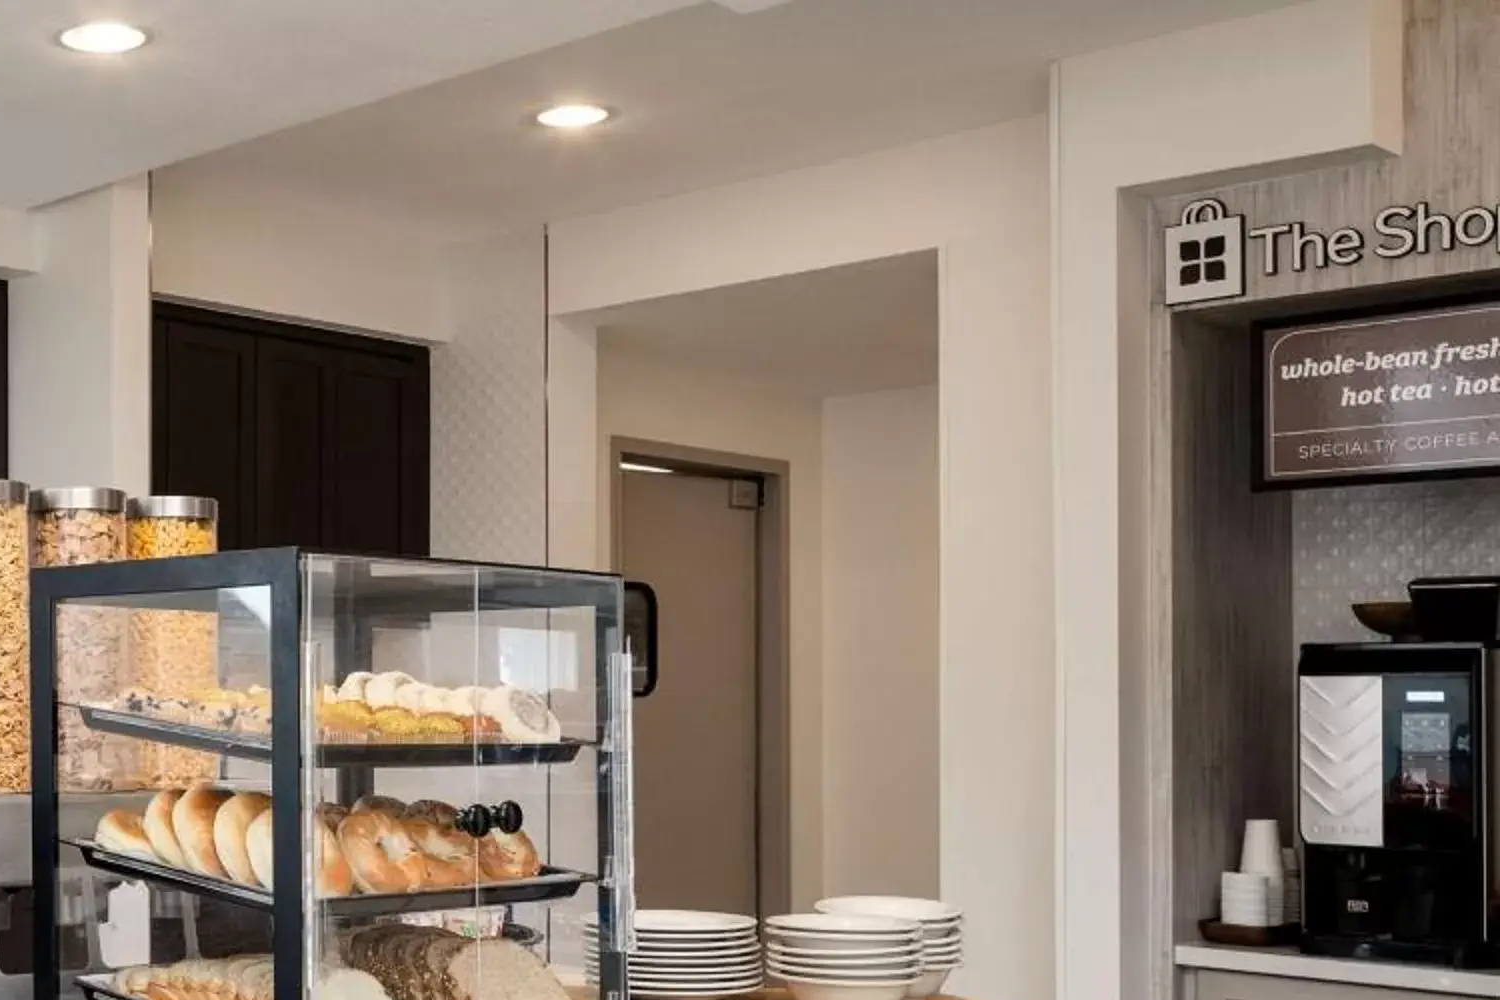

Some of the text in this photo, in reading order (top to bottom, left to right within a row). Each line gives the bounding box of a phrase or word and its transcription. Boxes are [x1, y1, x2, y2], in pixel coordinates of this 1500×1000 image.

[1248, 202, 1500, 276] The Sho
[1280, 350, 1429, 380] whole-bean
[1340, 374, 1500, 407] hot tea hot
[1299, 439, 1398, 460] SPECIALTY
[1404, 431, 1481, 451] COFFEE
